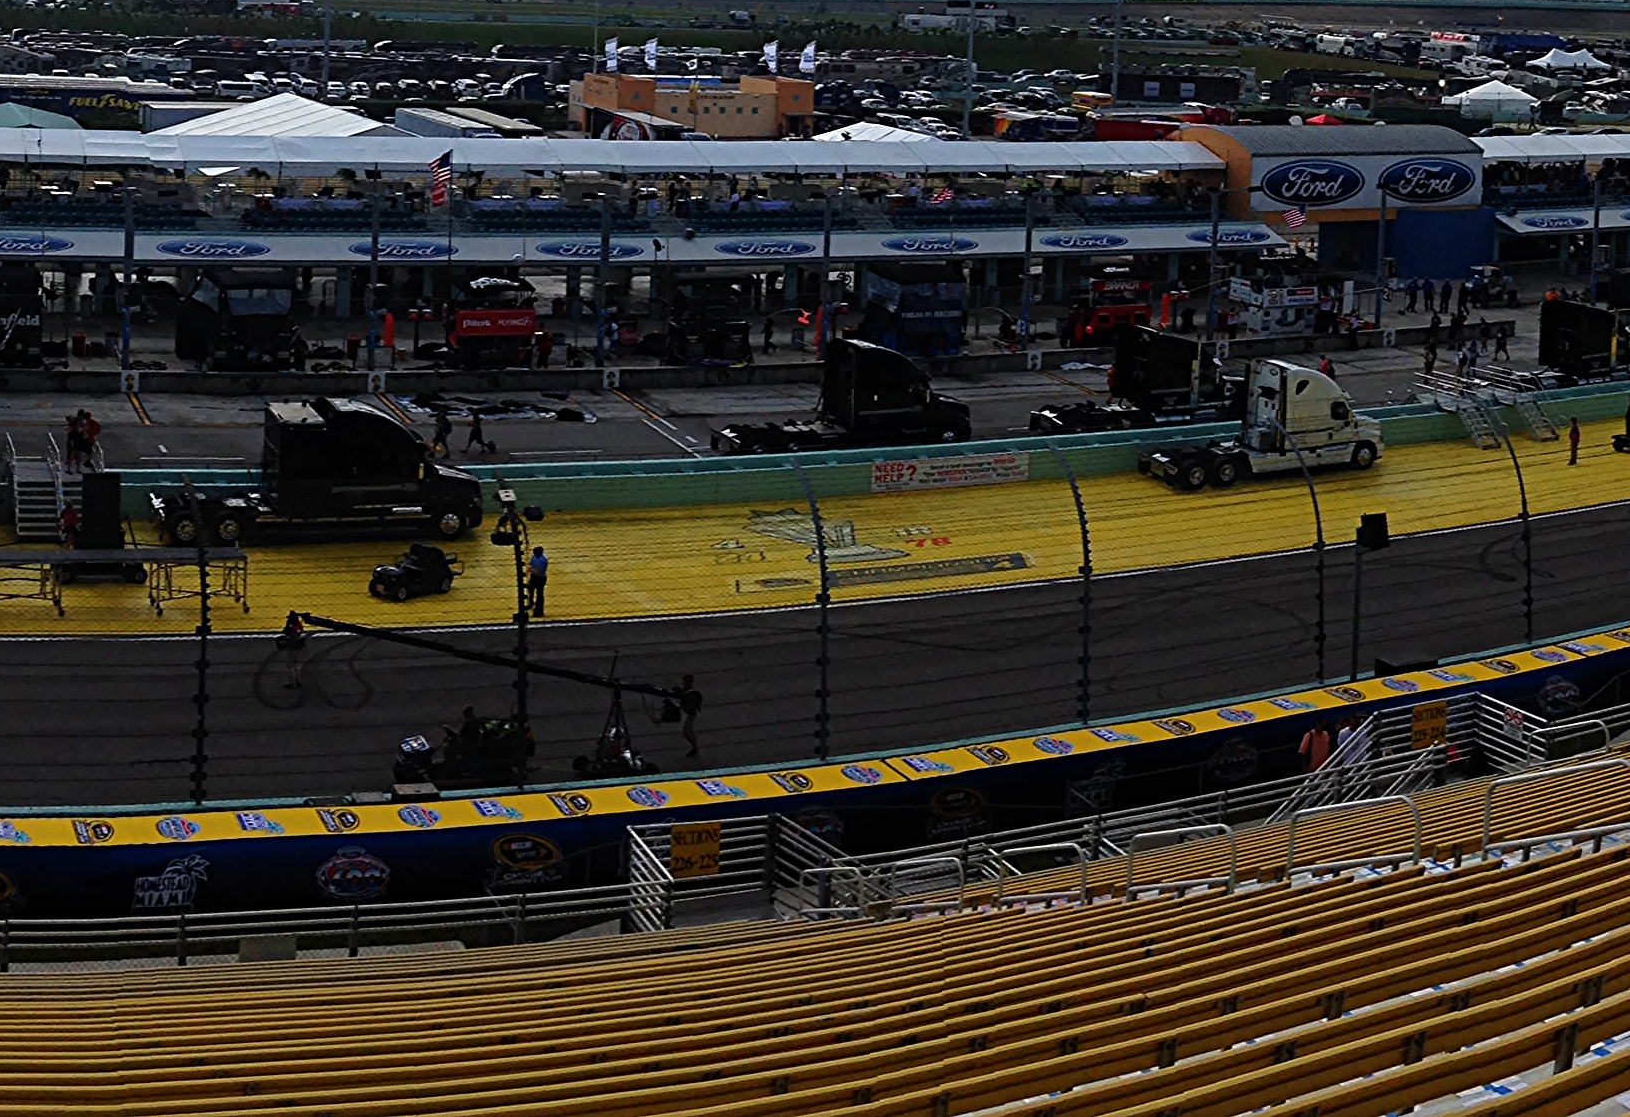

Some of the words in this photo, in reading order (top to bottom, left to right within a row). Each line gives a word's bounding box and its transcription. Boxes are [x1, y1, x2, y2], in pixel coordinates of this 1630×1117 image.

[69, 96, 97, 109] FUEL
[1281, 165, 1348, 198] Ford
[1397, 164, 1460, 195] Ford
[182, 237, 243, 256] Ford
[377, 241, 435, 258] Ford
[743, 240, 798, 256] Ford
[911, 238, 960, 252] Ford
[463, 317, 493, 328] Pilot
[874, 463, 904, 473] NEED
[874, 473, 905, 483] HELP
[673, 829, 719, 847] SECTIONS
[673, 852, 719, 872] 226-225
[134, 874, 190, 891] HOMESTEAD
[331, 868, 379, 889] 400
[131, 891, 191, 907] MIAMI
